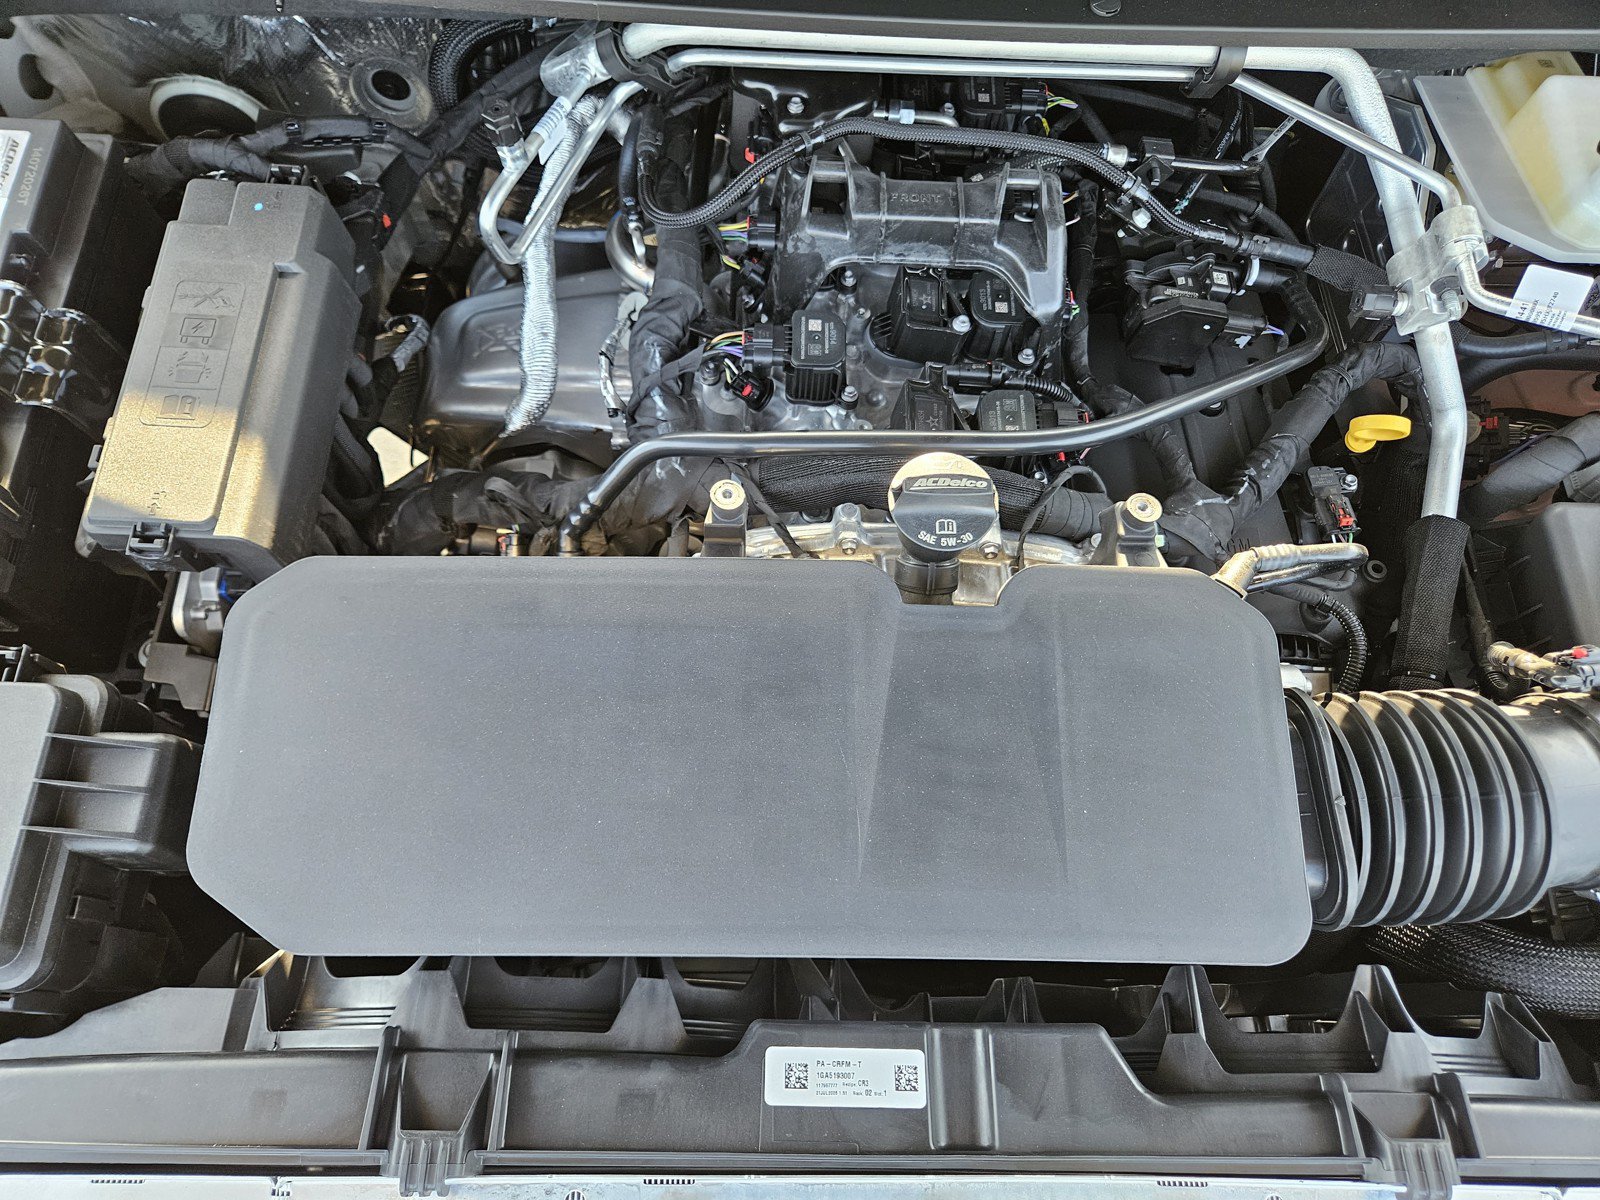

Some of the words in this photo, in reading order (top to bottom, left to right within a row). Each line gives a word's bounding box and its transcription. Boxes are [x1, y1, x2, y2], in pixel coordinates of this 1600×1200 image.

[890, 192, 941, 203] FRONT
[912, 477, 988, 488] ACDelco
[917, 530, 937, 545] SAE
[940, 532, 974, 547] 5W-30
